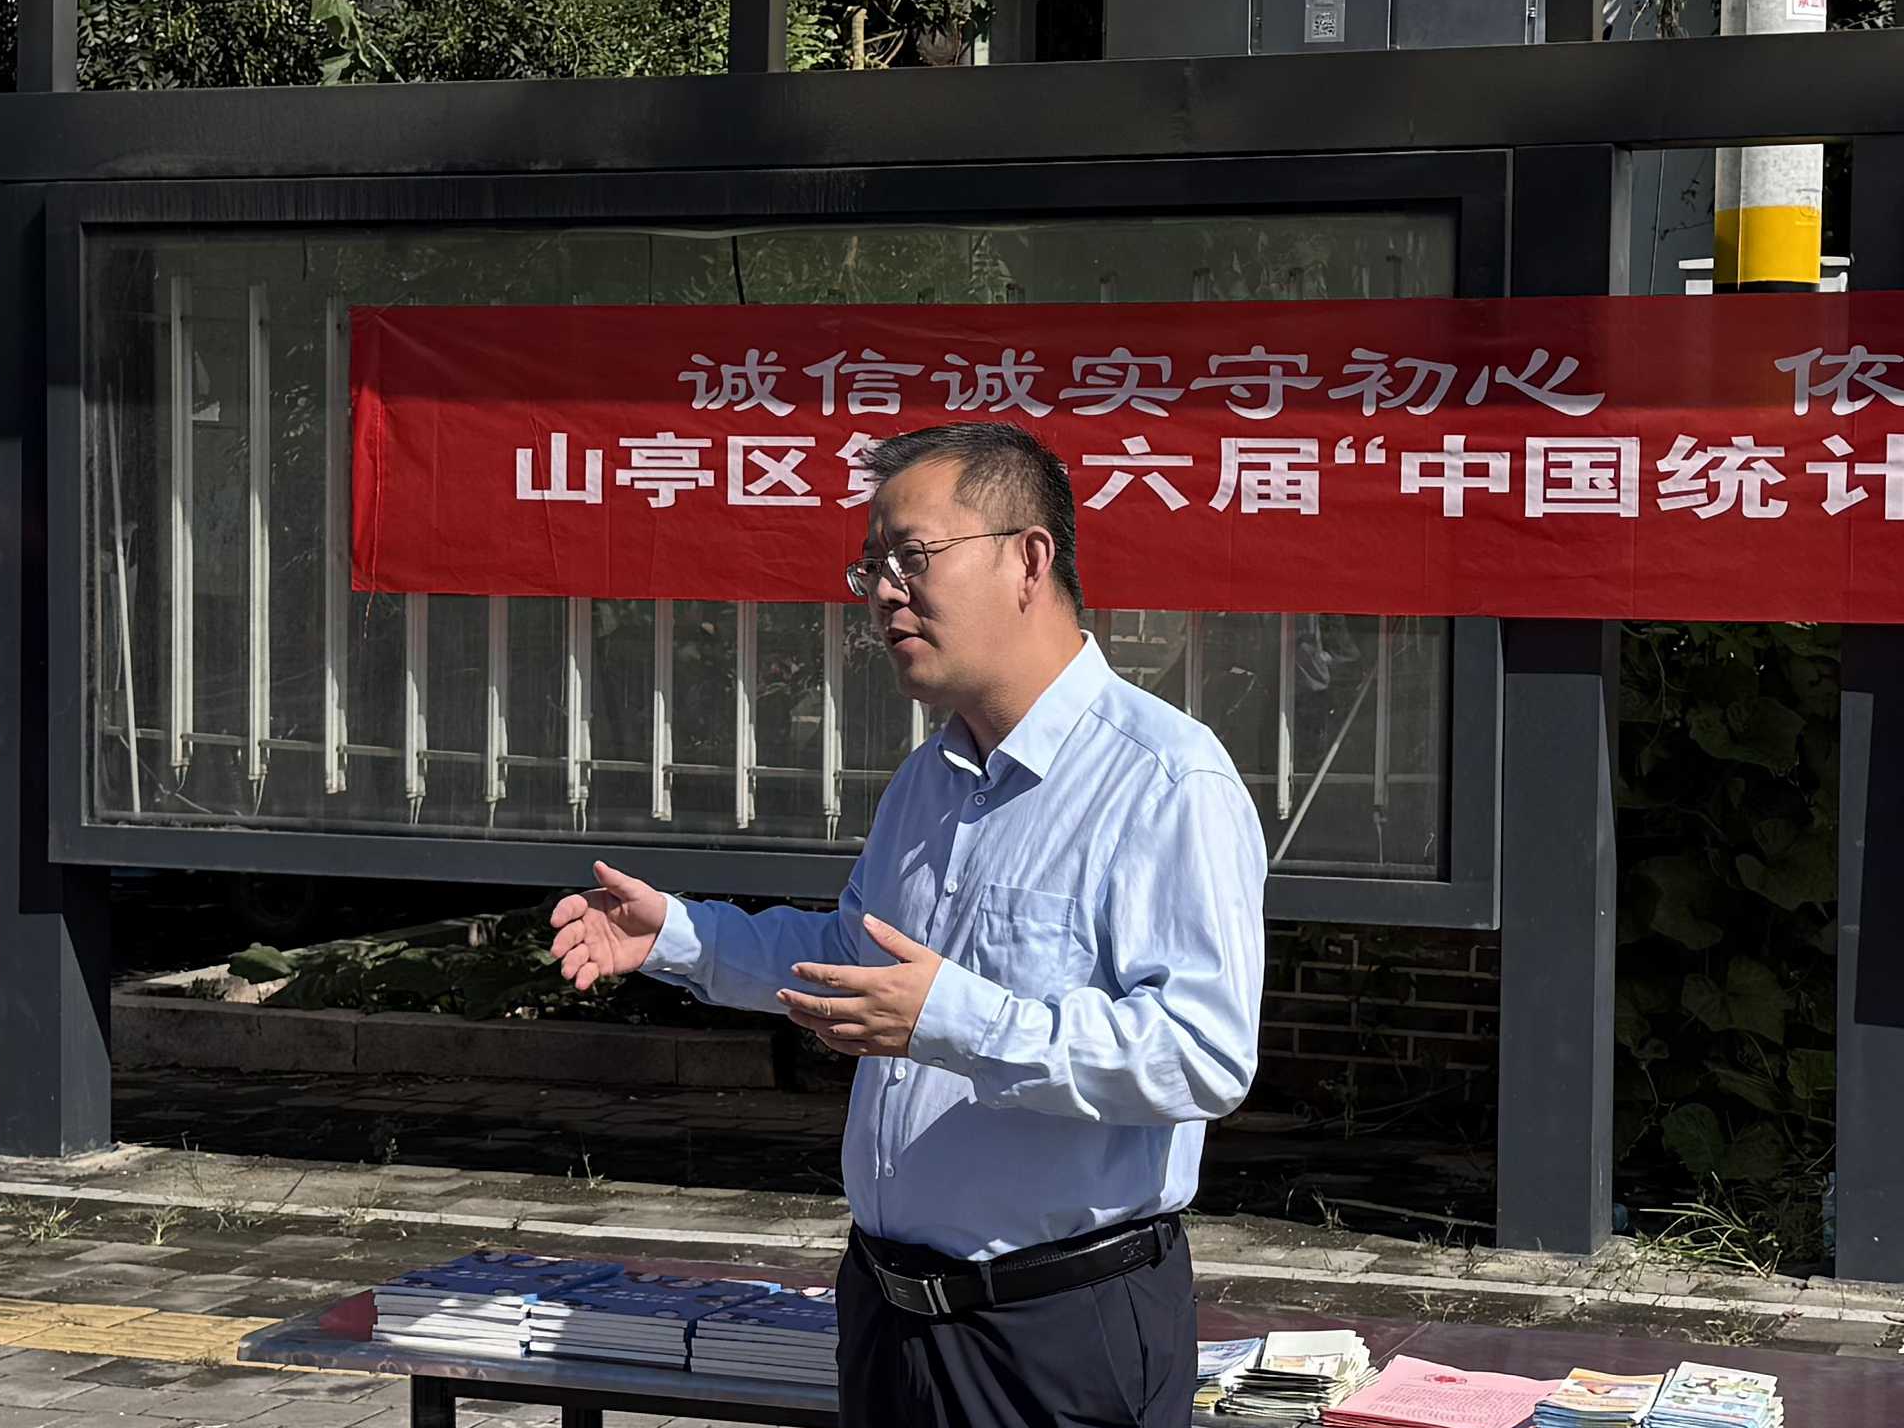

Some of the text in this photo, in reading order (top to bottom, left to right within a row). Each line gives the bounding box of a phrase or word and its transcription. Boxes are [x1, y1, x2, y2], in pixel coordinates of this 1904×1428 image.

[677, 346, 1606, 419] 诚信诚实守初心
